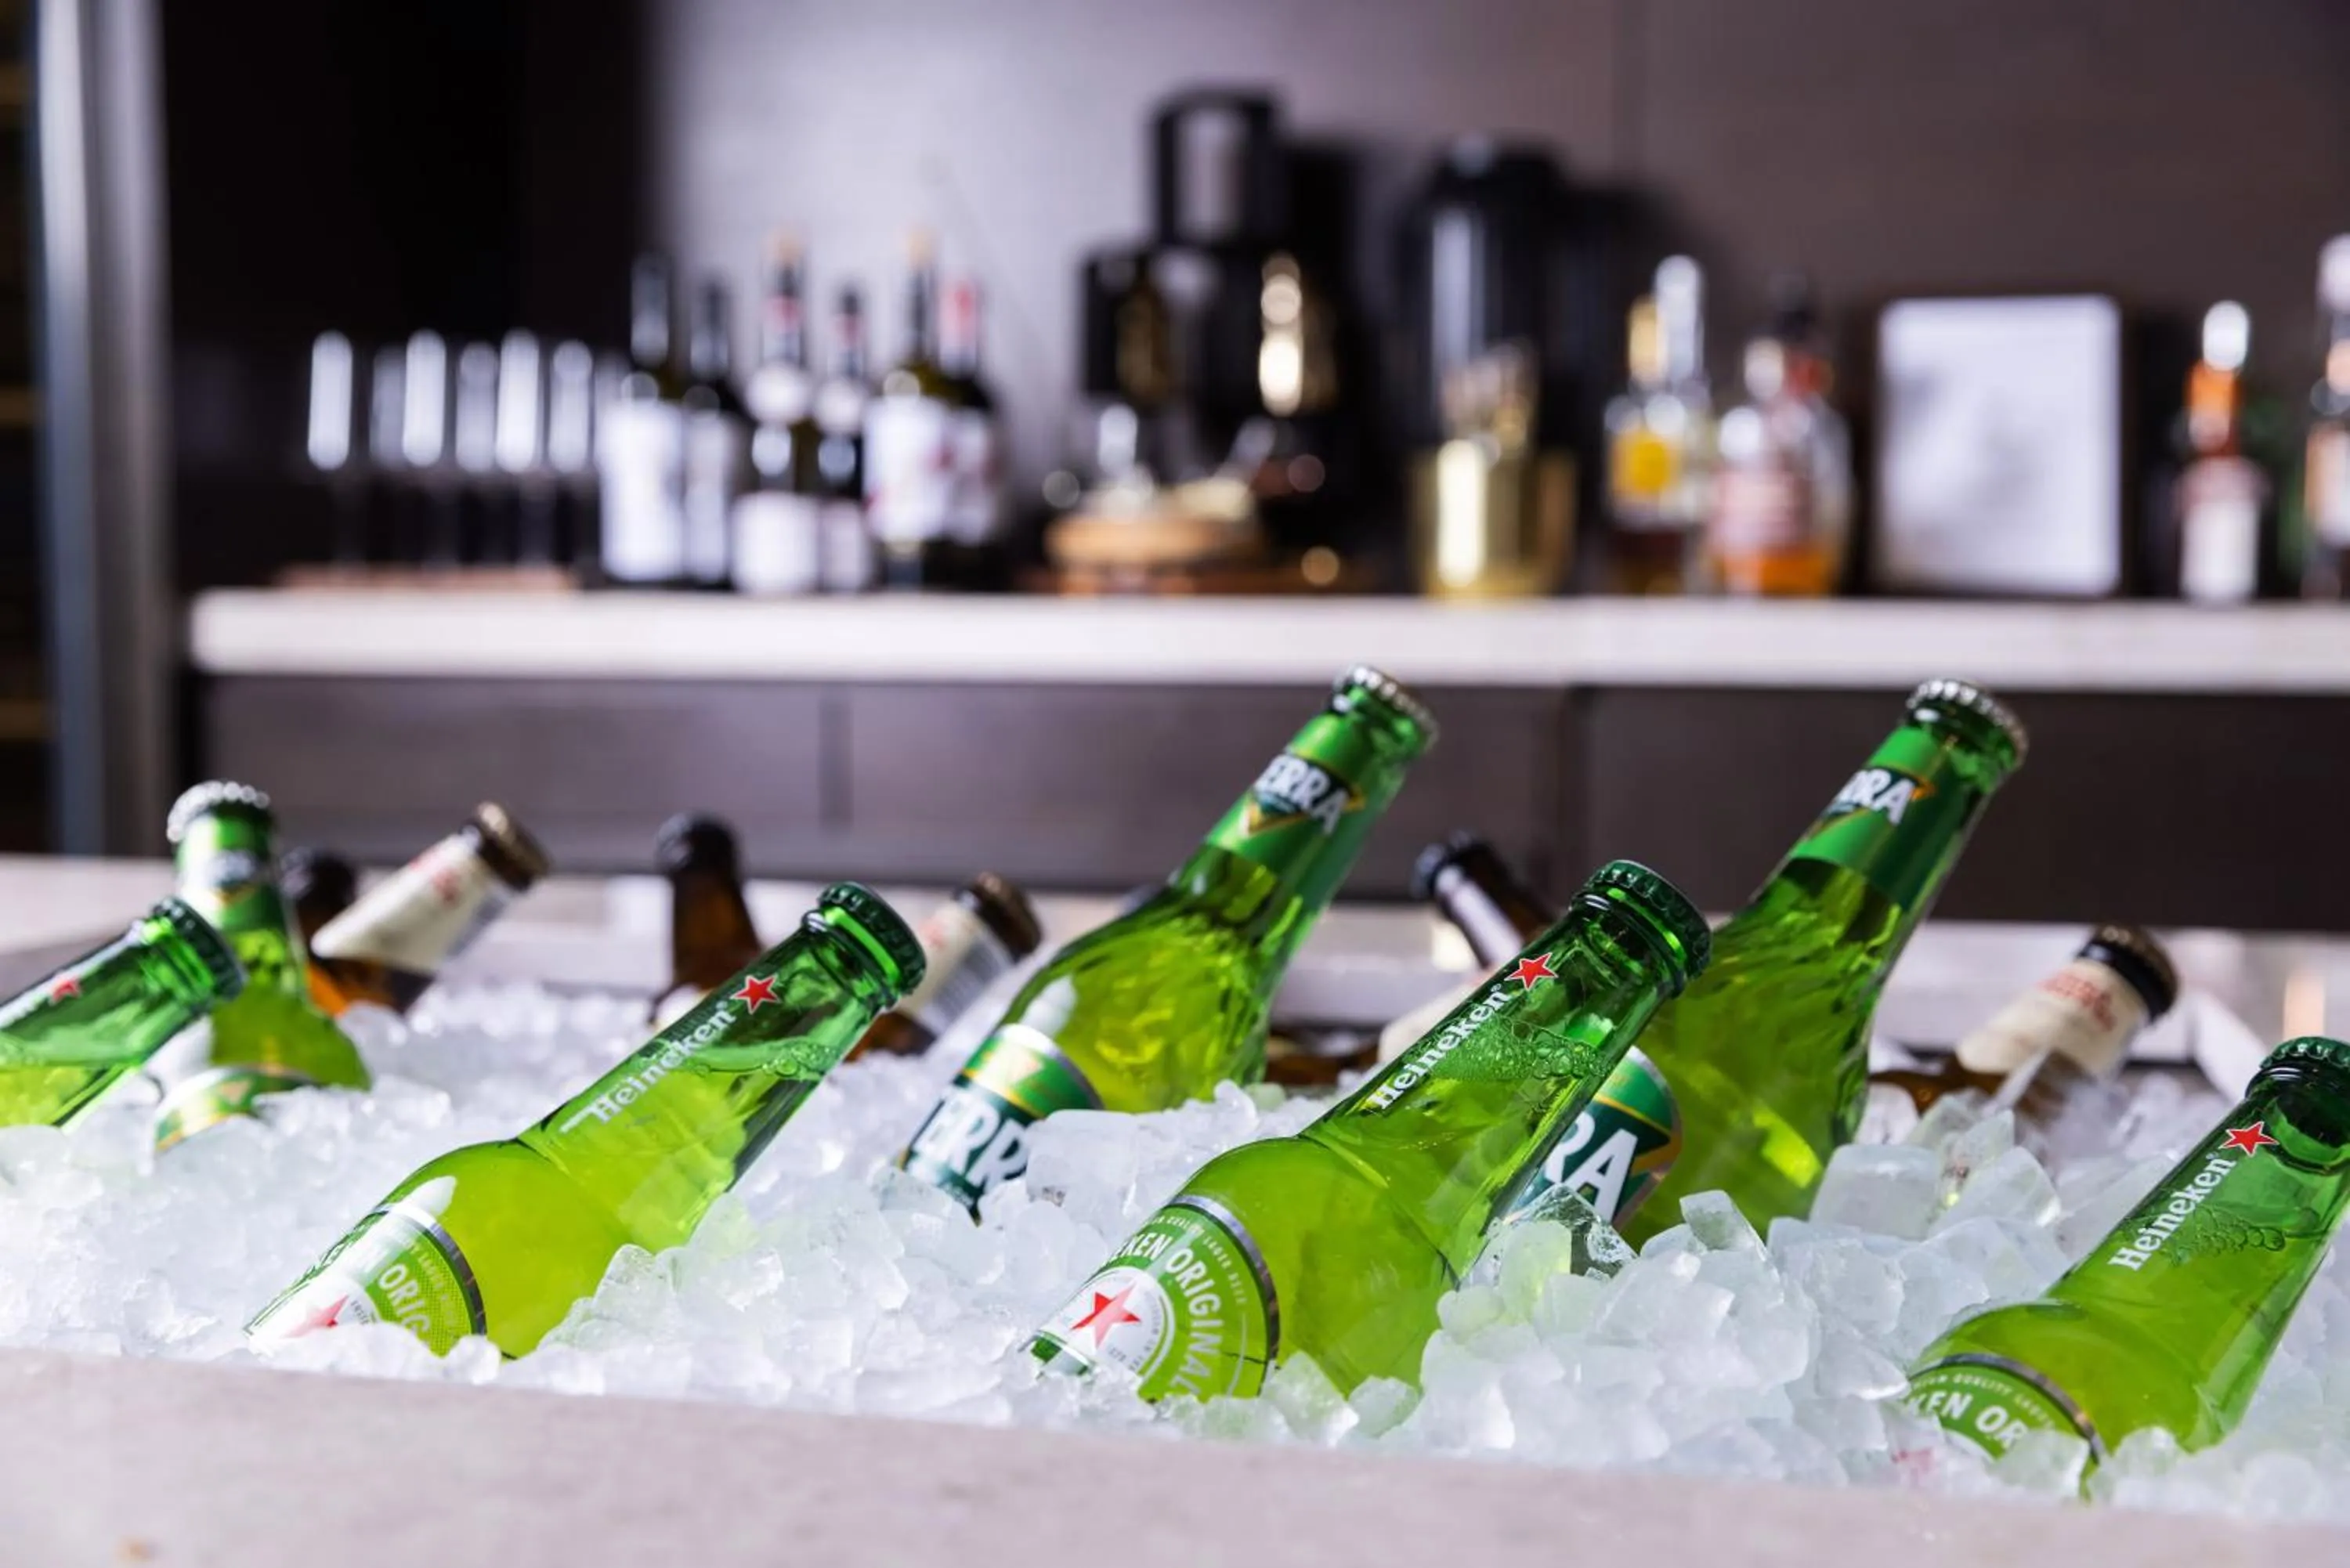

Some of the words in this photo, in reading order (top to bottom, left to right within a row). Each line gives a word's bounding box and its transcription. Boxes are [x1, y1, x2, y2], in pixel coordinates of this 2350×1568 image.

[591, 1009, 737, 1124] Heineken
[1365, 991, 1512, 1110] Heineken
[2107, 1157, 2237, 1271] Heineken
[1165, 1248, 1224, 1397] ORIGINAL
